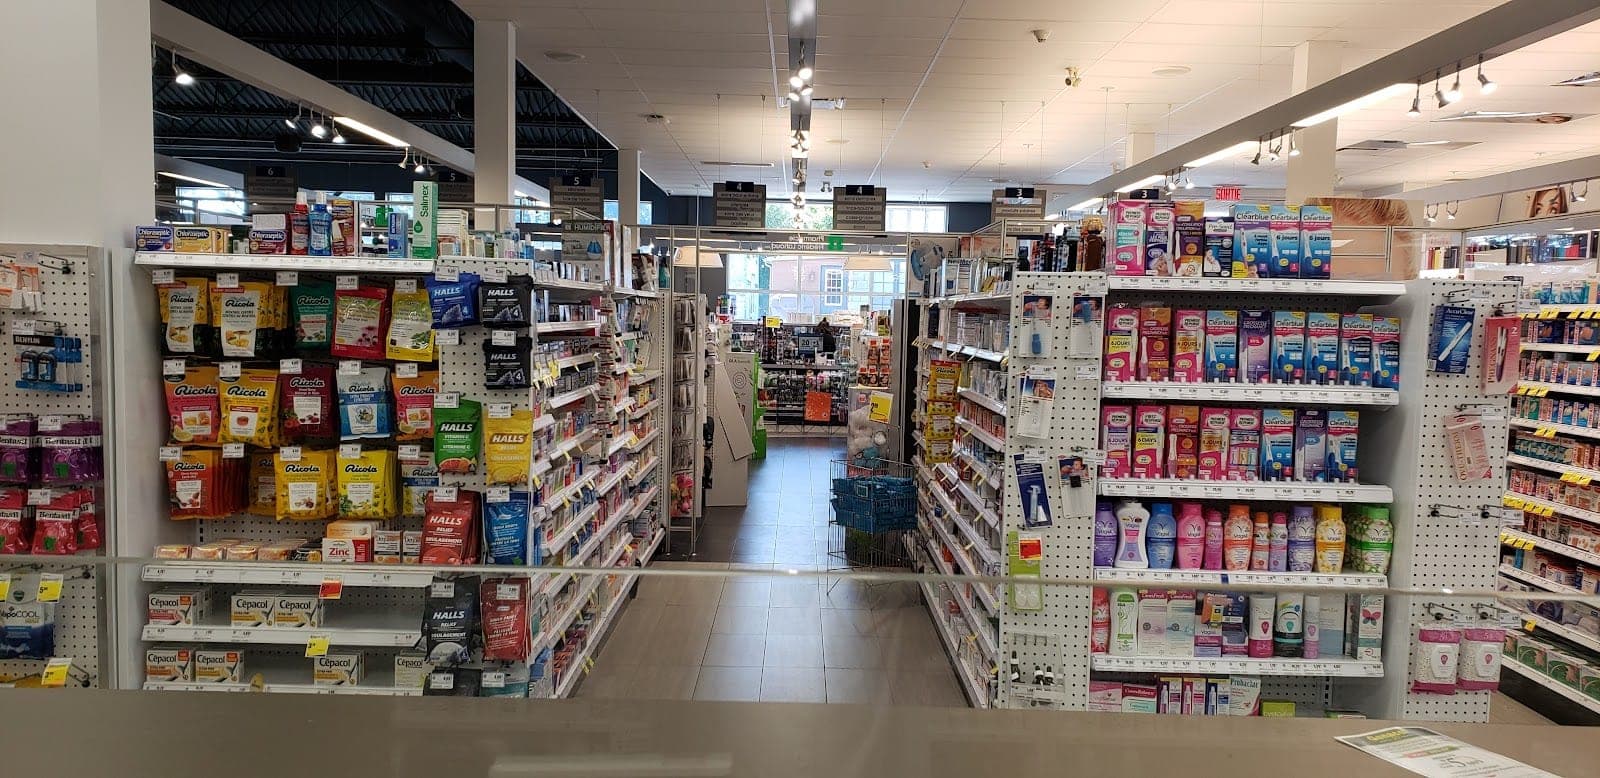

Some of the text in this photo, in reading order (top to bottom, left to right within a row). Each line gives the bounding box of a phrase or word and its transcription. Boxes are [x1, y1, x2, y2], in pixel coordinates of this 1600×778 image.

[574, 177, 580, 185] 5
[1016, 189, 1022, 197] 3
[1141, 190, 1148, 198] 3
[1215, 188, 1241, 200] SORTIE
[420, 184, 430, 218] Salinex
[1236, 213, 1270, 221] Clearblue
[1270, 214, 1299, 222] Clearblue
[1303, 214, 1332, 222] Clearblue
[434, 286, 461, 296] HALLS
[488, 288, 514, 296] HALLS
[170, 294, 194, 303] Ricola
[297, 295, 330, 306] Ricola
[224, 299, 255, 308] Ricola
[290, 378, 325, 388] Ricola
[175, 385, 218, 396] Ricola
[228, 386, 267, 398] Ricola
[348, 385, 376, 393] Ricola
[400, 386, 436, 396] Ricola
[440, 423, 473, 432] HALLS
[0, 436, 28, 444] entasil
[44, 437, 83, 446] Bentasil
[492, 434, 525, 443] HALLS
[175, 462, 206, 471] Ricola
[285, 464, 320, 474] Ricola
[345, 464, 378, 474] Ricola
[412, 469, 438, 477] Ricola
[39, 510, 72, 519] Bentasil
[429, 516, 463, 526] HALLS
[329, 547, 350, 557] Zinc
[432, 610, 465, 620] HALLS
